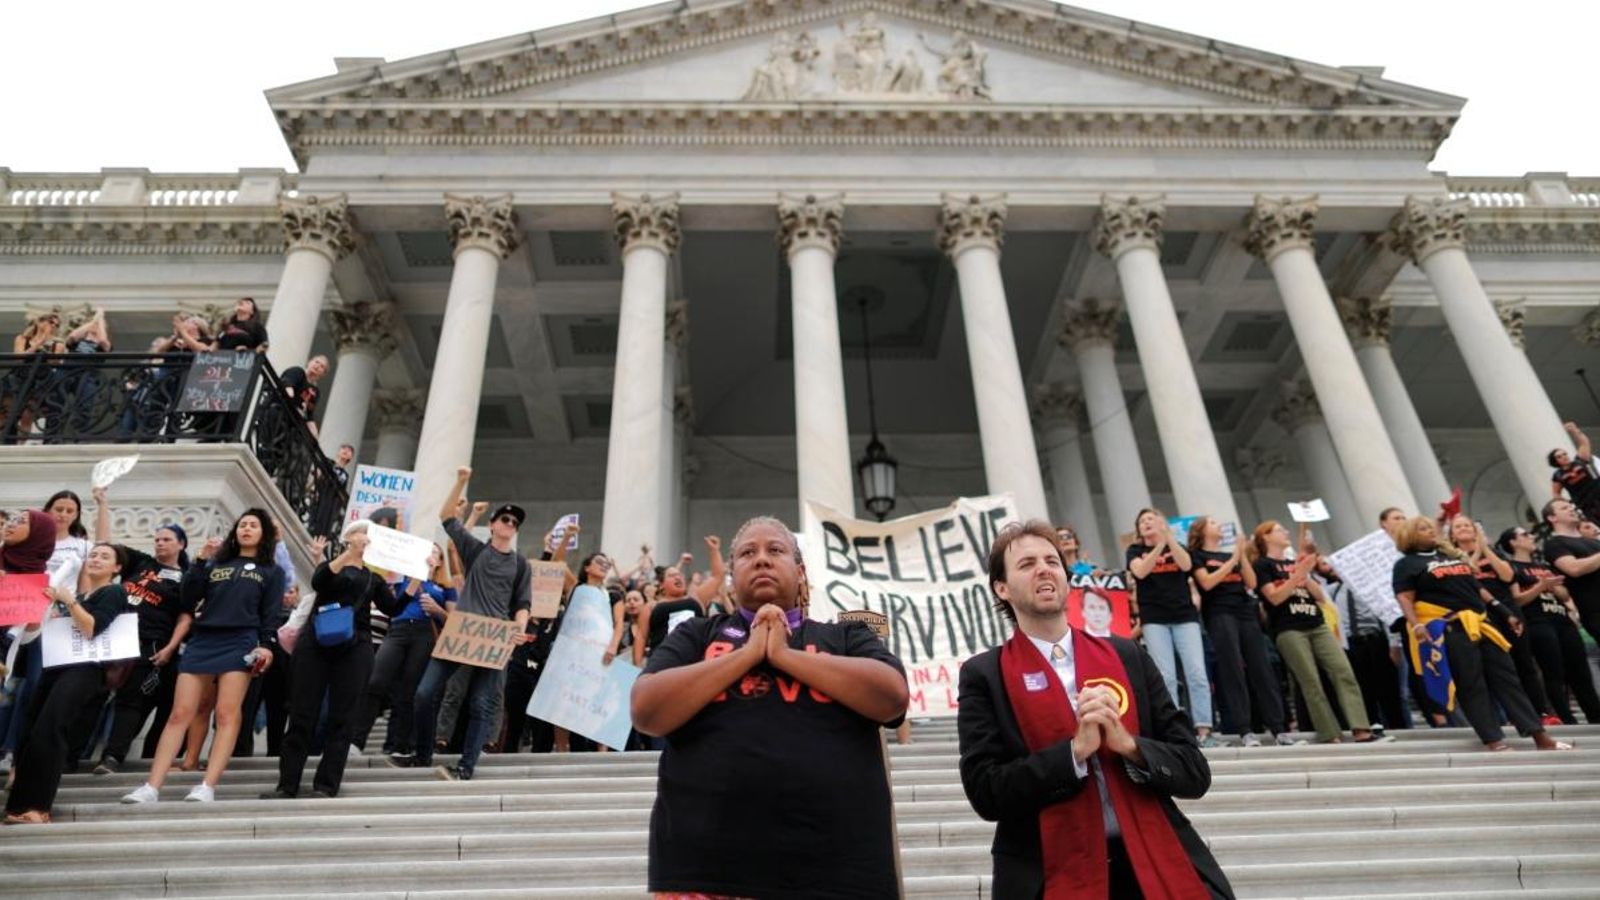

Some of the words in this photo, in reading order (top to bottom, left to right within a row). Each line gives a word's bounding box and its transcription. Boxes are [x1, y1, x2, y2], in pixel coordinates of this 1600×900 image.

[360, 470, 414, 492] WOMEN
[1289, 602, 1317, 617] VOTE
[825, 580, 1008, 663] SURVIVO
[912, 667, 931, 686] IN
[936, 665, 951, 683] A
